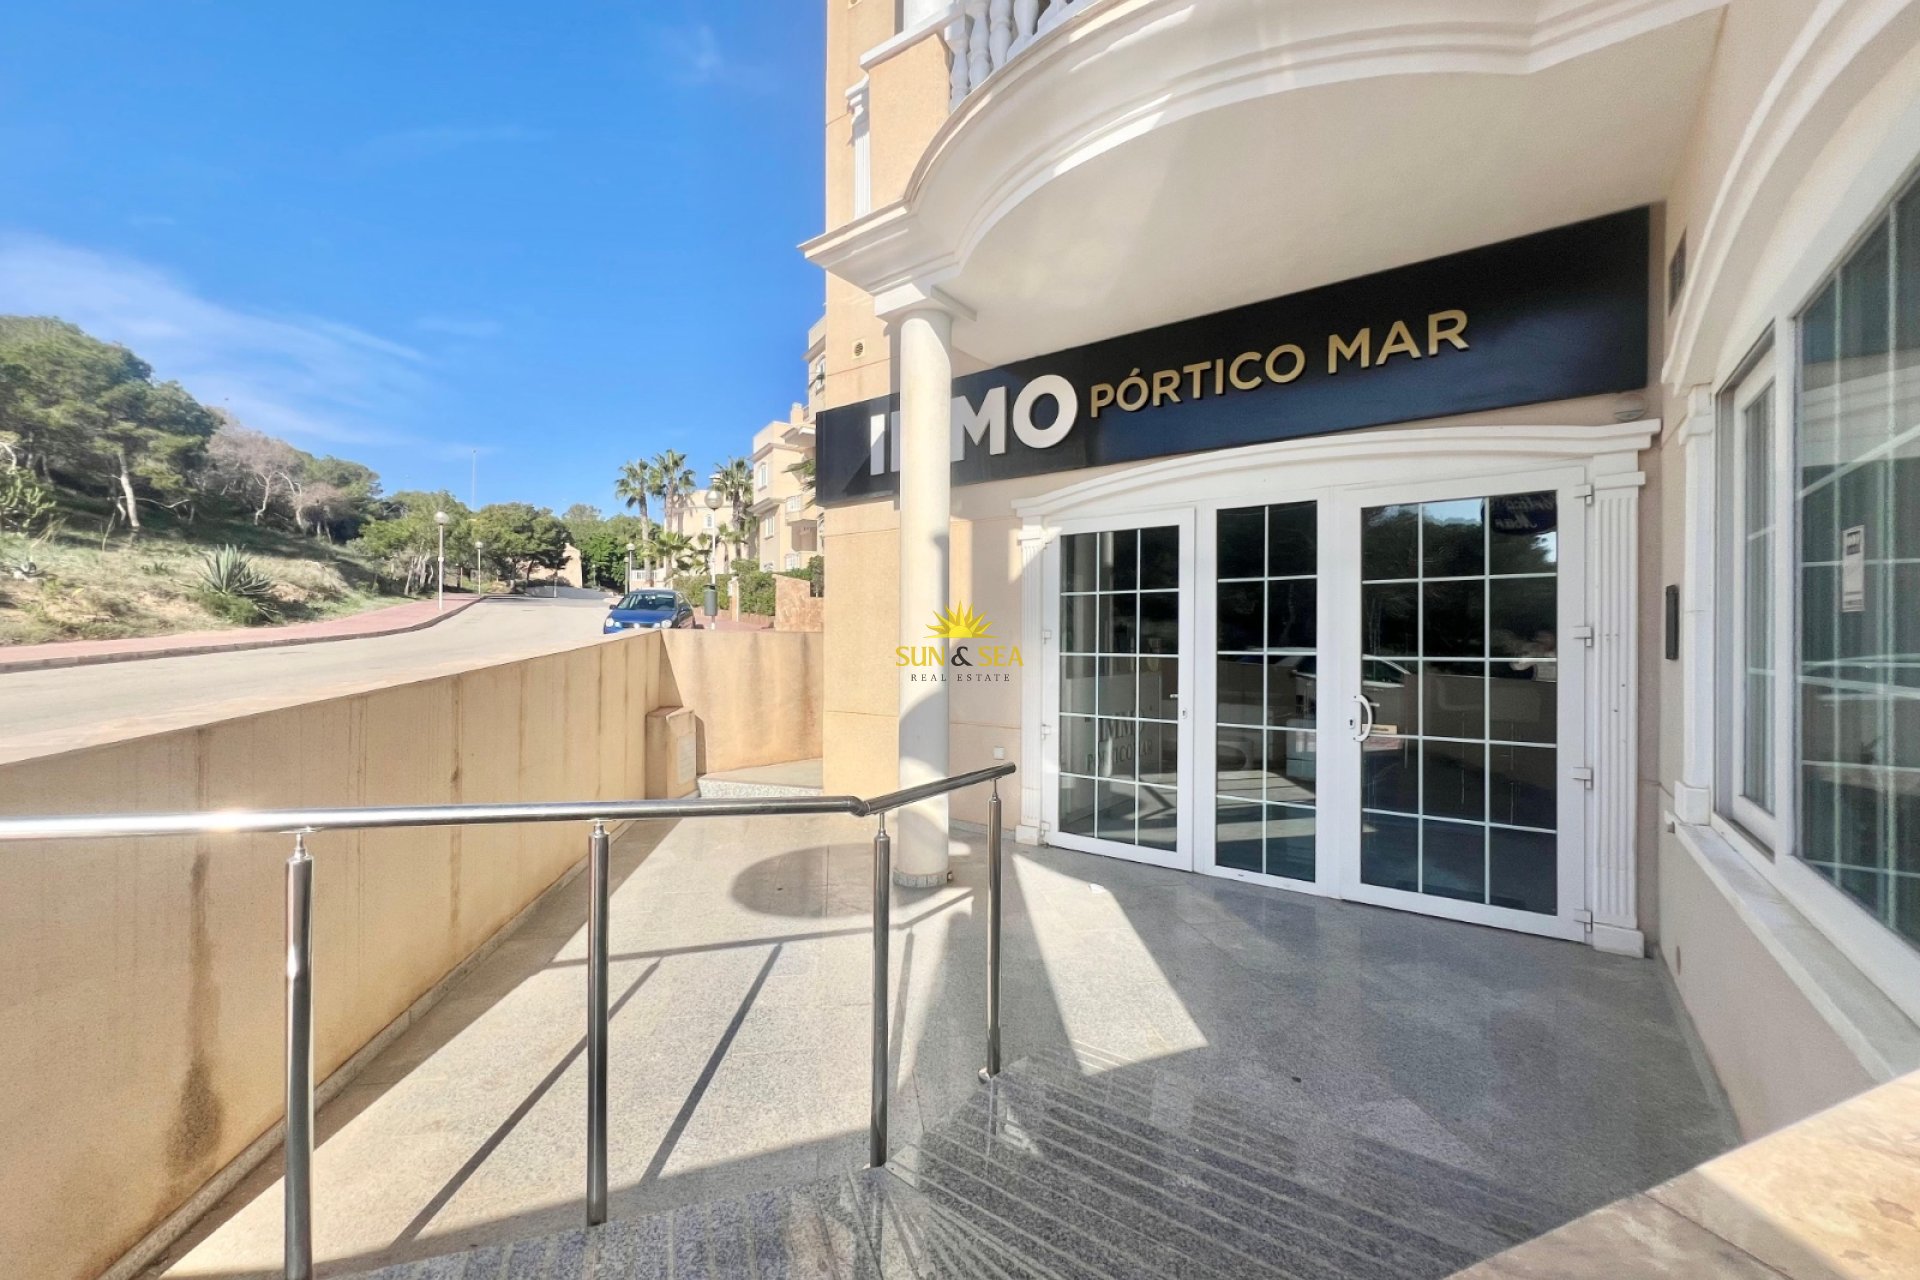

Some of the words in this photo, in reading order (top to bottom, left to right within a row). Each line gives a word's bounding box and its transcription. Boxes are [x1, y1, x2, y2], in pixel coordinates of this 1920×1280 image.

[870, 374, 1078, 476] IMO
[1090, 344, 1306, 419] PÓRTICO
[1327, 309, 1470, 375] MAR
